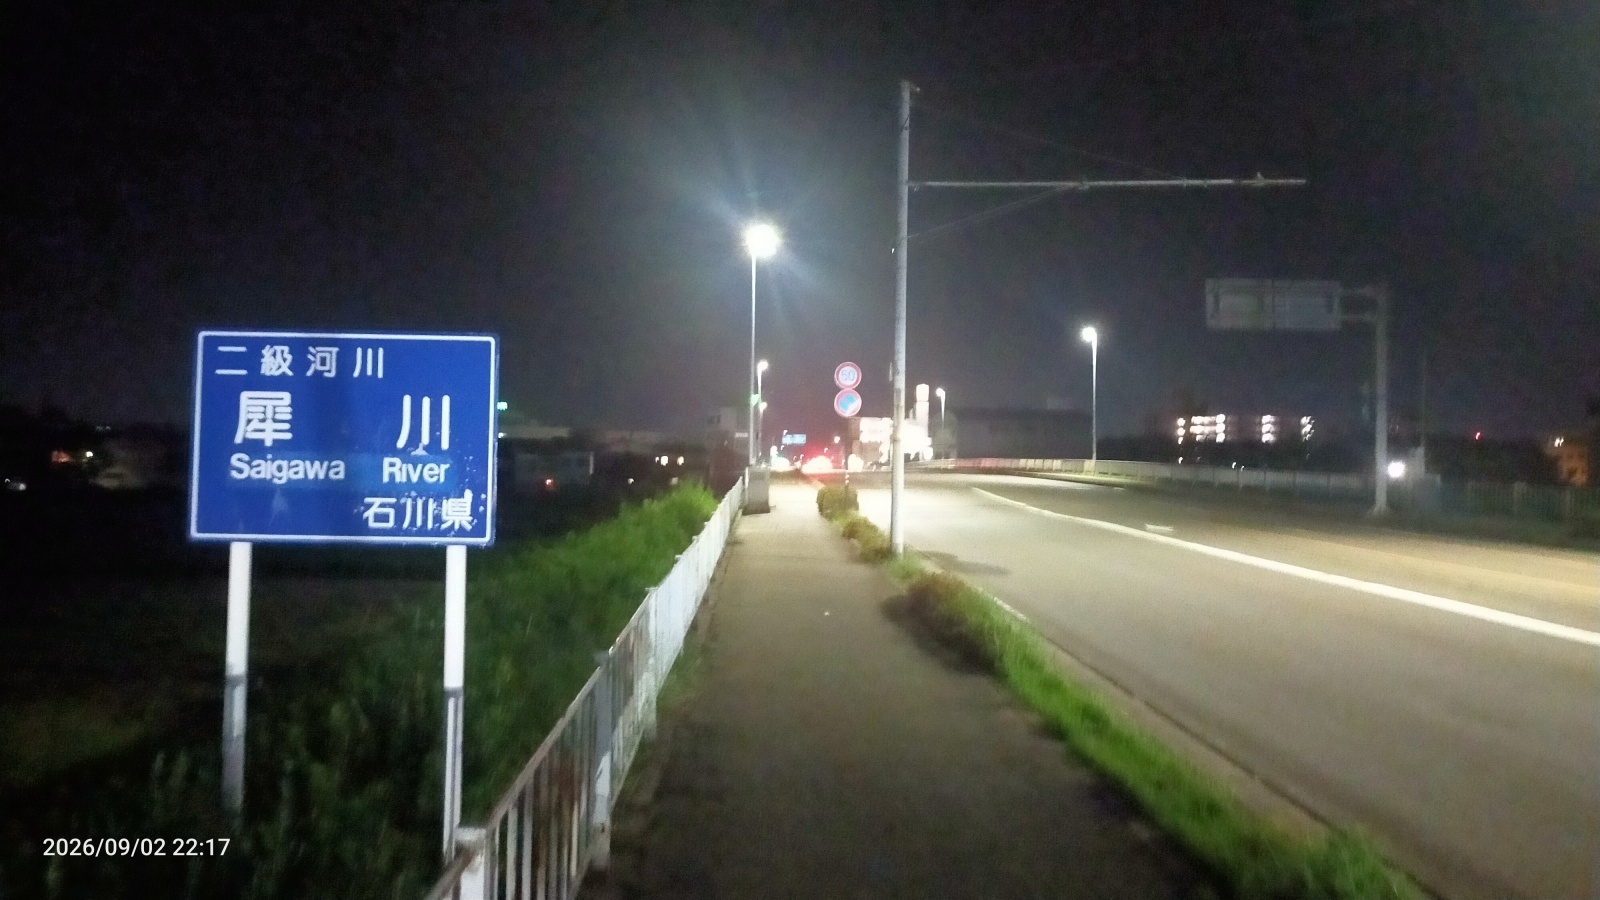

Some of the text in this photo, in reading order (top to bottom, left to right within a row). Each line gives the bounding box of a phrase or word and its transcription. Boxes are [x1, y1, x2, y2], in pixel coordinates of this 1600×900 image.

[215, 345, 384, 378] 二級河川
[841, 369, 855, 381] 50
[230, 453, 450, 484] Saigawa River
[363, 496, 474, 530] 石川県
